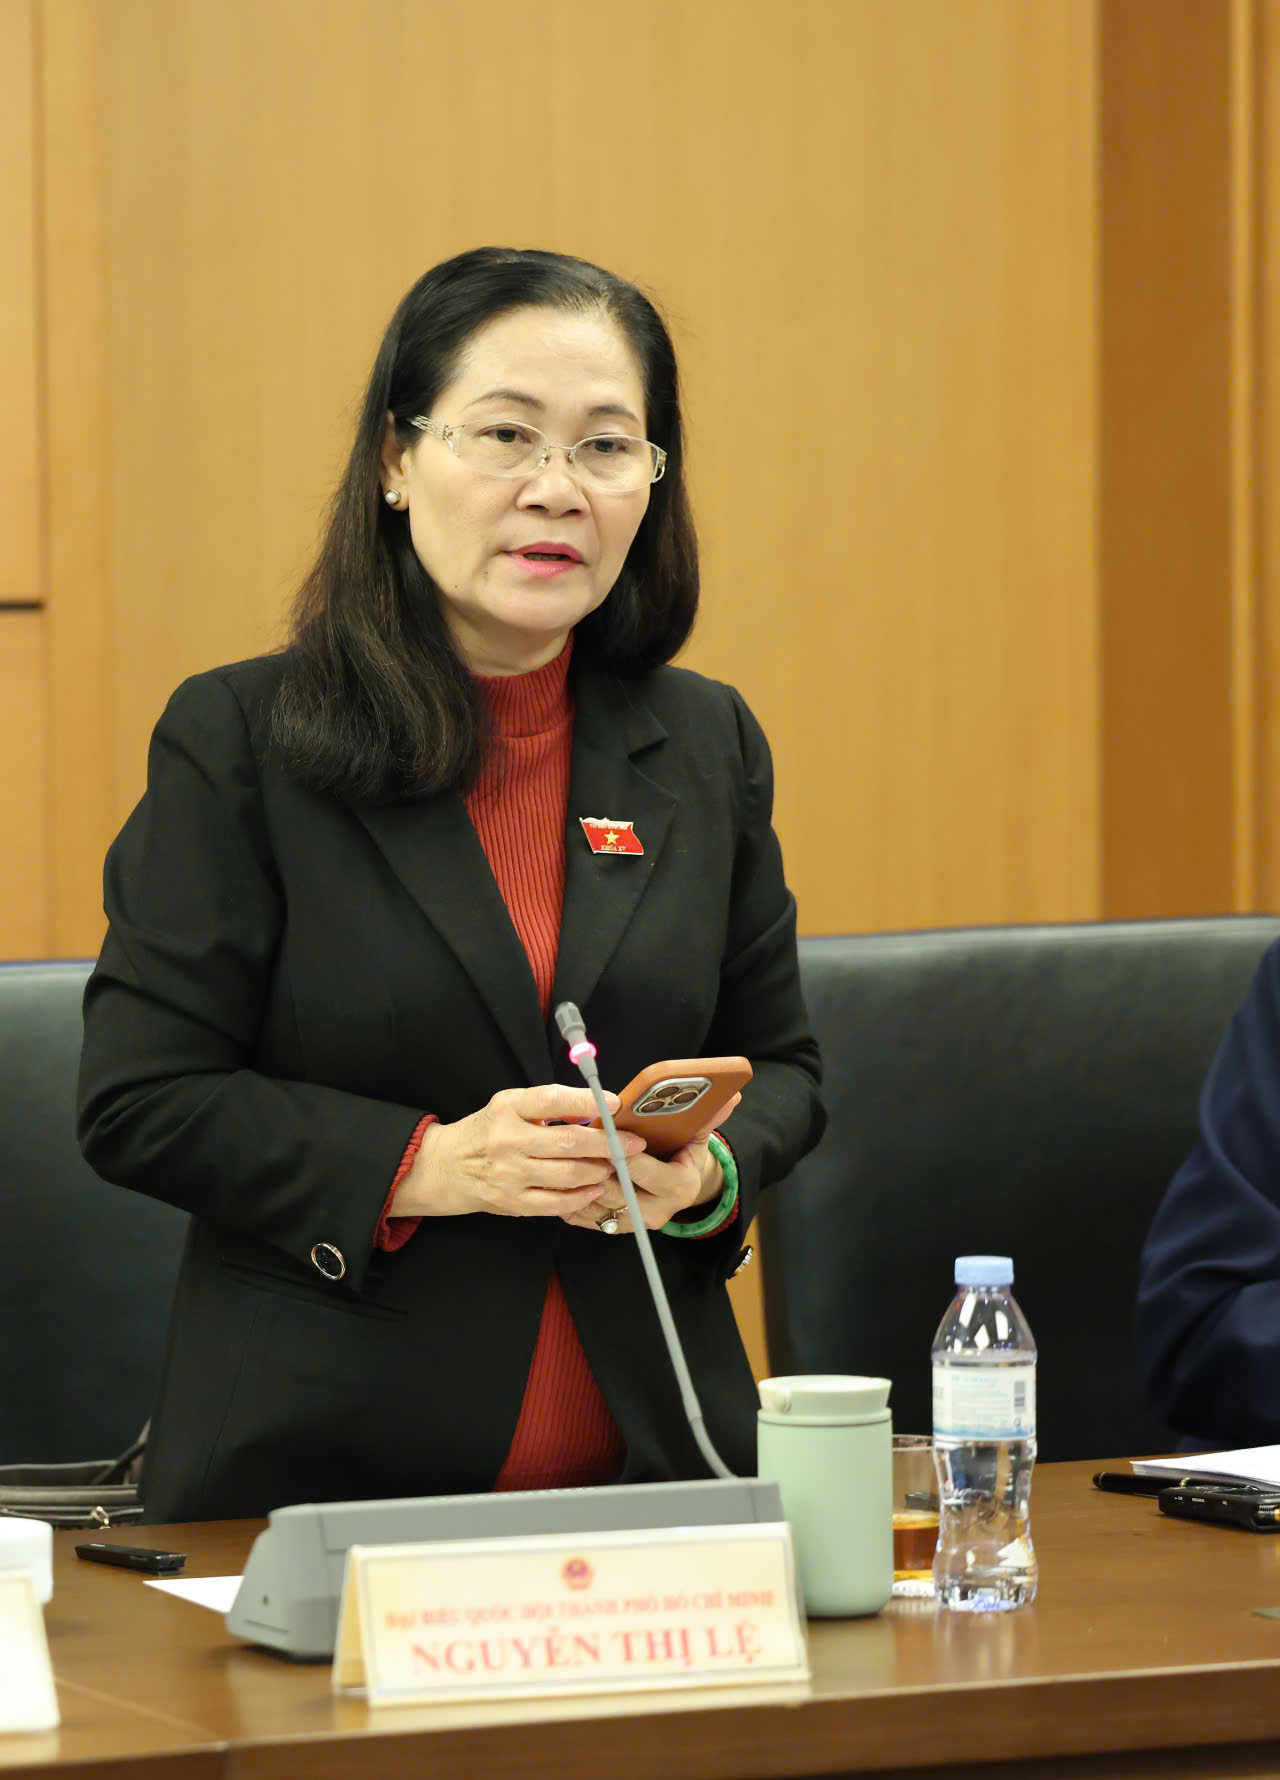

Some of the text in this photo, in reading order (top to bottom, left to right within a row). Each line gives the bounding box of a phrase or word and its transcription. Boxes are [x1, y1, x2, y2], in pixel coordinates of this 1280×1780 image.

[727, 1589, 774, 1609] MINH
[410, 1619, 762, 1674] NGUYỄN THỊ LỆ
